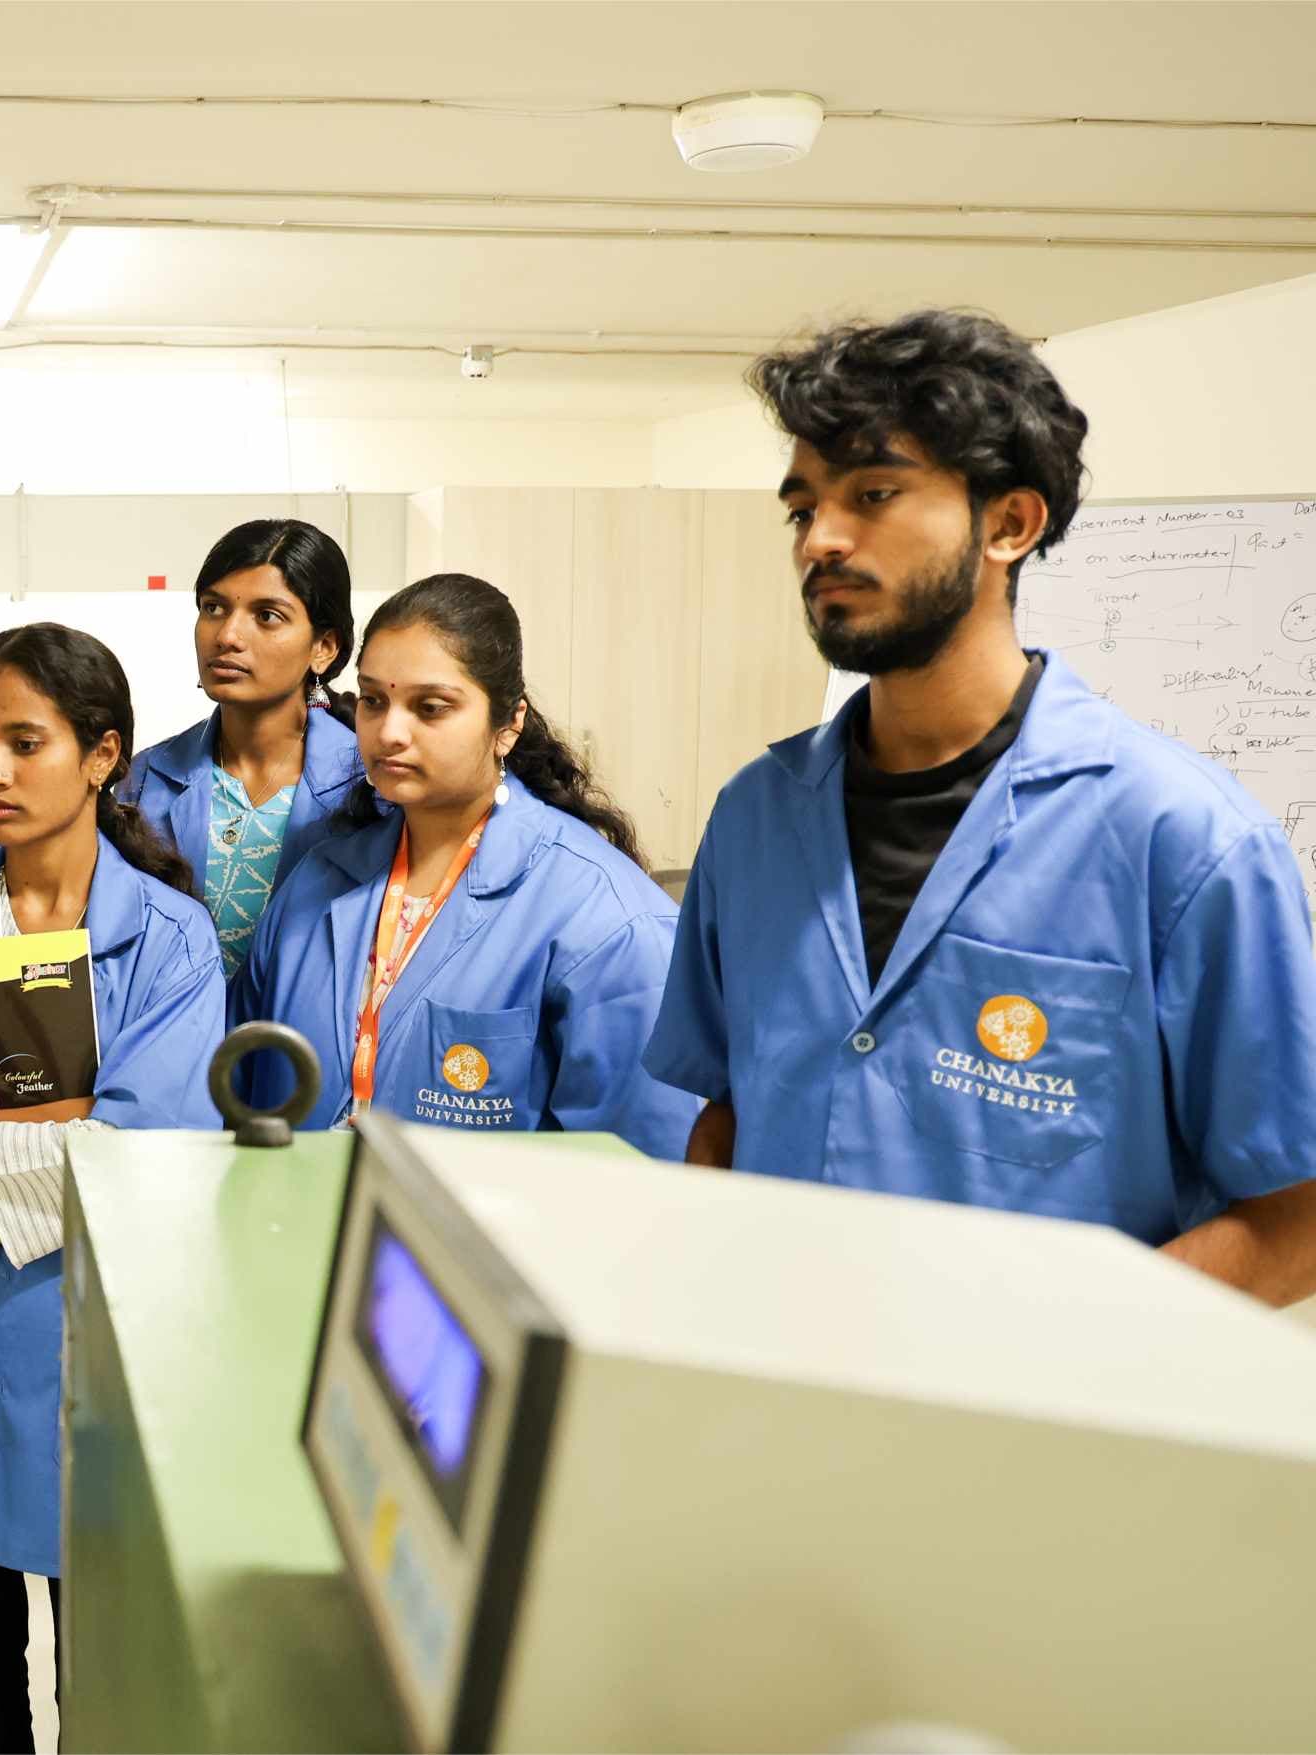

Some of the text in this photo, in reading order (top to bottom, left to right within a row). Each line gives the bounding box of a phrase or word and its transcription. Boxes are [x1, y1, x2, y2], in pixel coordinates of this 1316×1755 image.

[1068, 513, 1146, 534] xperiment
[1247, 680, 1316, 697] Manome
[936, 1047, 1077, 1097] CHANAKYA
[16, 1082, 54, 1095] Feather
[931, 1069, 1075, 1116] UNIVERSITY
[418, 1088, 514, 1112] CHANAKYA
[415, 1104, 513, 1125] UNIVERSITY
